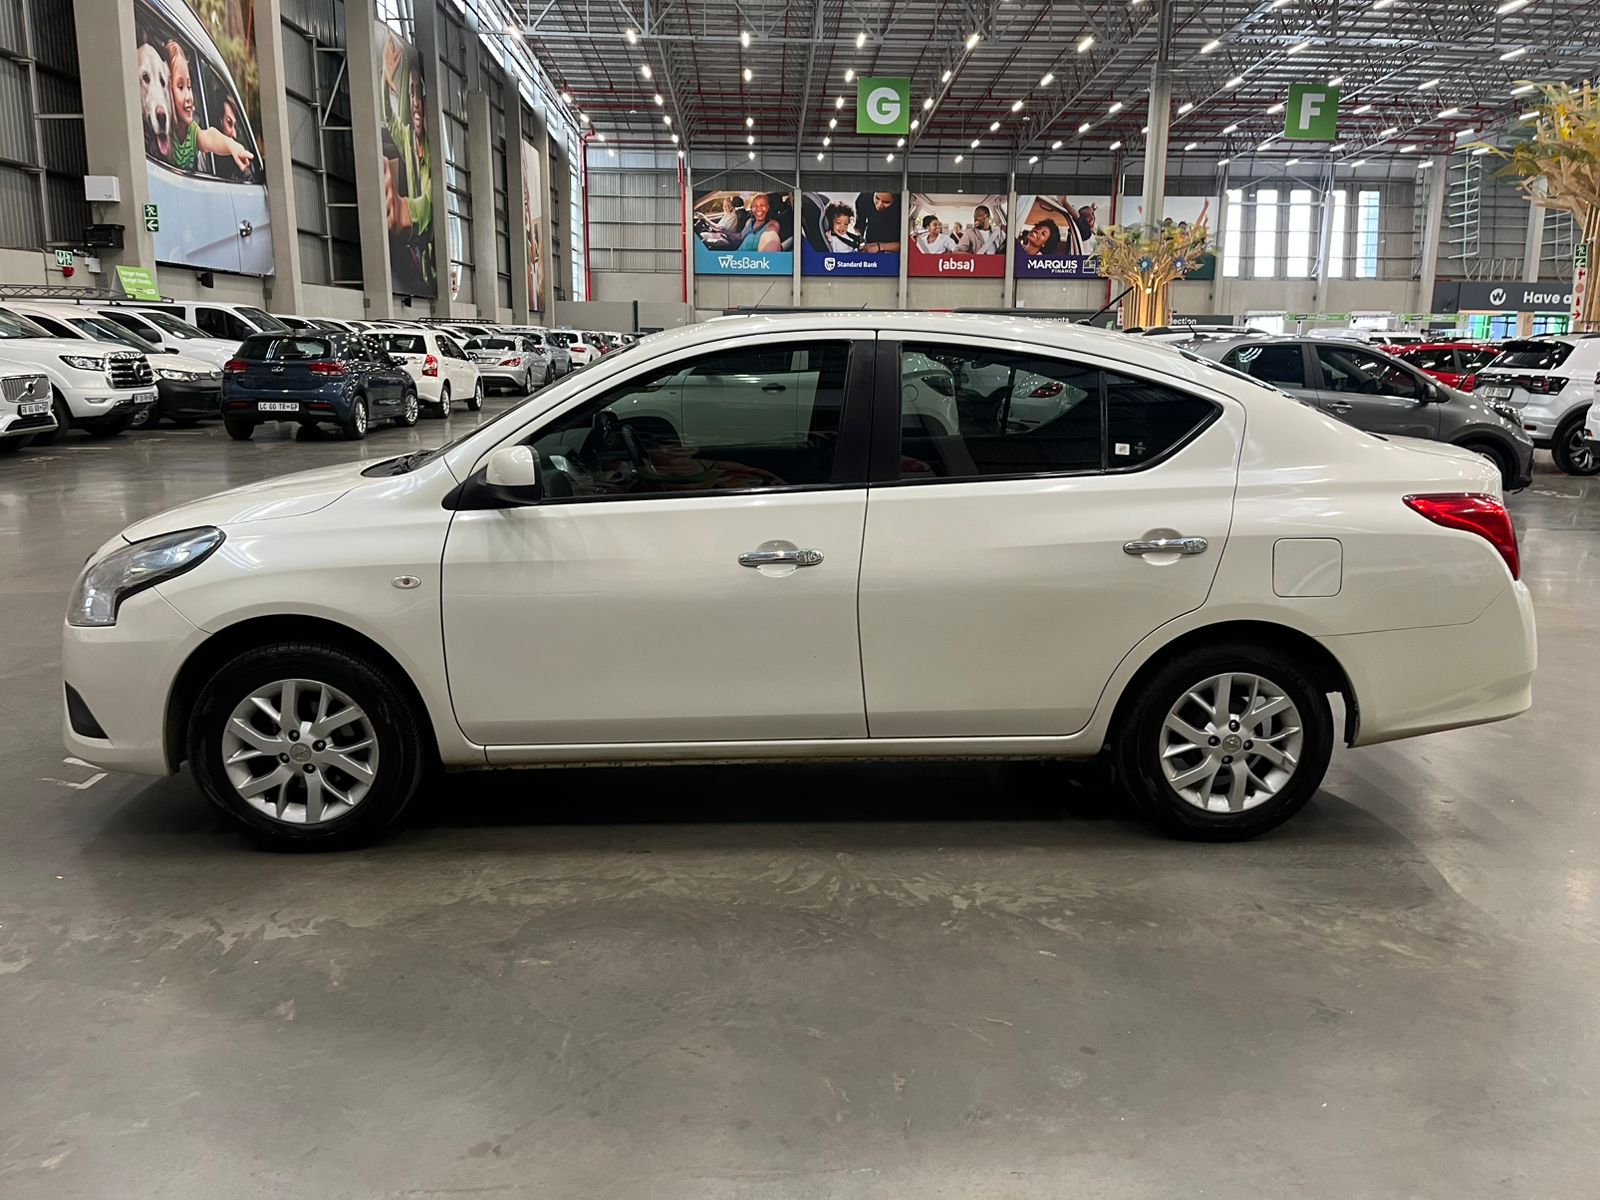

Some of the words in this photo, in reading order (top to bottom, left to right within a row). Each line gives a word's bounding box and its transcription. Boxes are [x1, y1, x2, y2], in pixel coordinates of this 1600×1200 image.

[866, 87, 901, 125] G
[1299, 93, 1326, 130] F
[718, 255, 770, 269] WesBank
[1027, 260, 1078, 269] MARQUIS
[1523, 291, 1560, 304] Have
